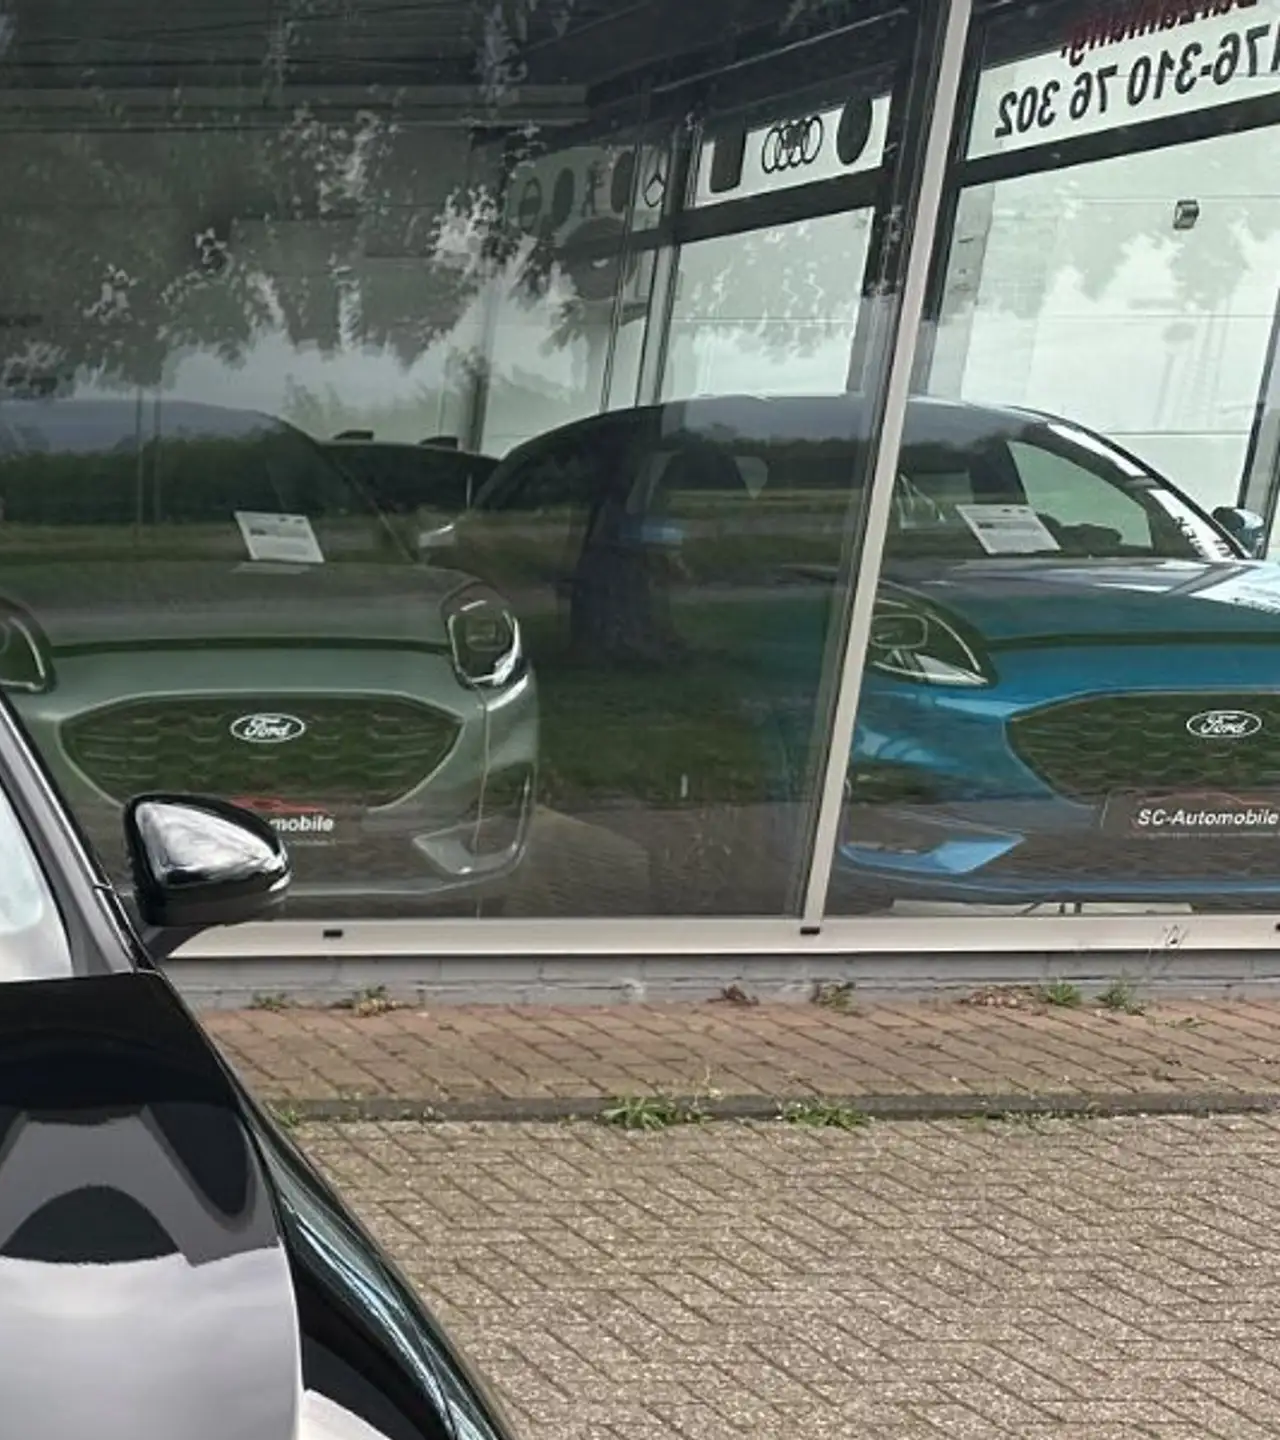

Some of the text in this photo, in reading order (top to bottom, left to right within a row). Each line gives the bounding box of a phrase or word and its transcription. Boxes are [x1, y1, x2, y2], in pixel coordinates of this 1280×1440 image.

[241, 715, 296, 739] Ford
[1197, 713, 1252, 735] Ford
[1137, 808, 1279, 826] SC-Automobile
